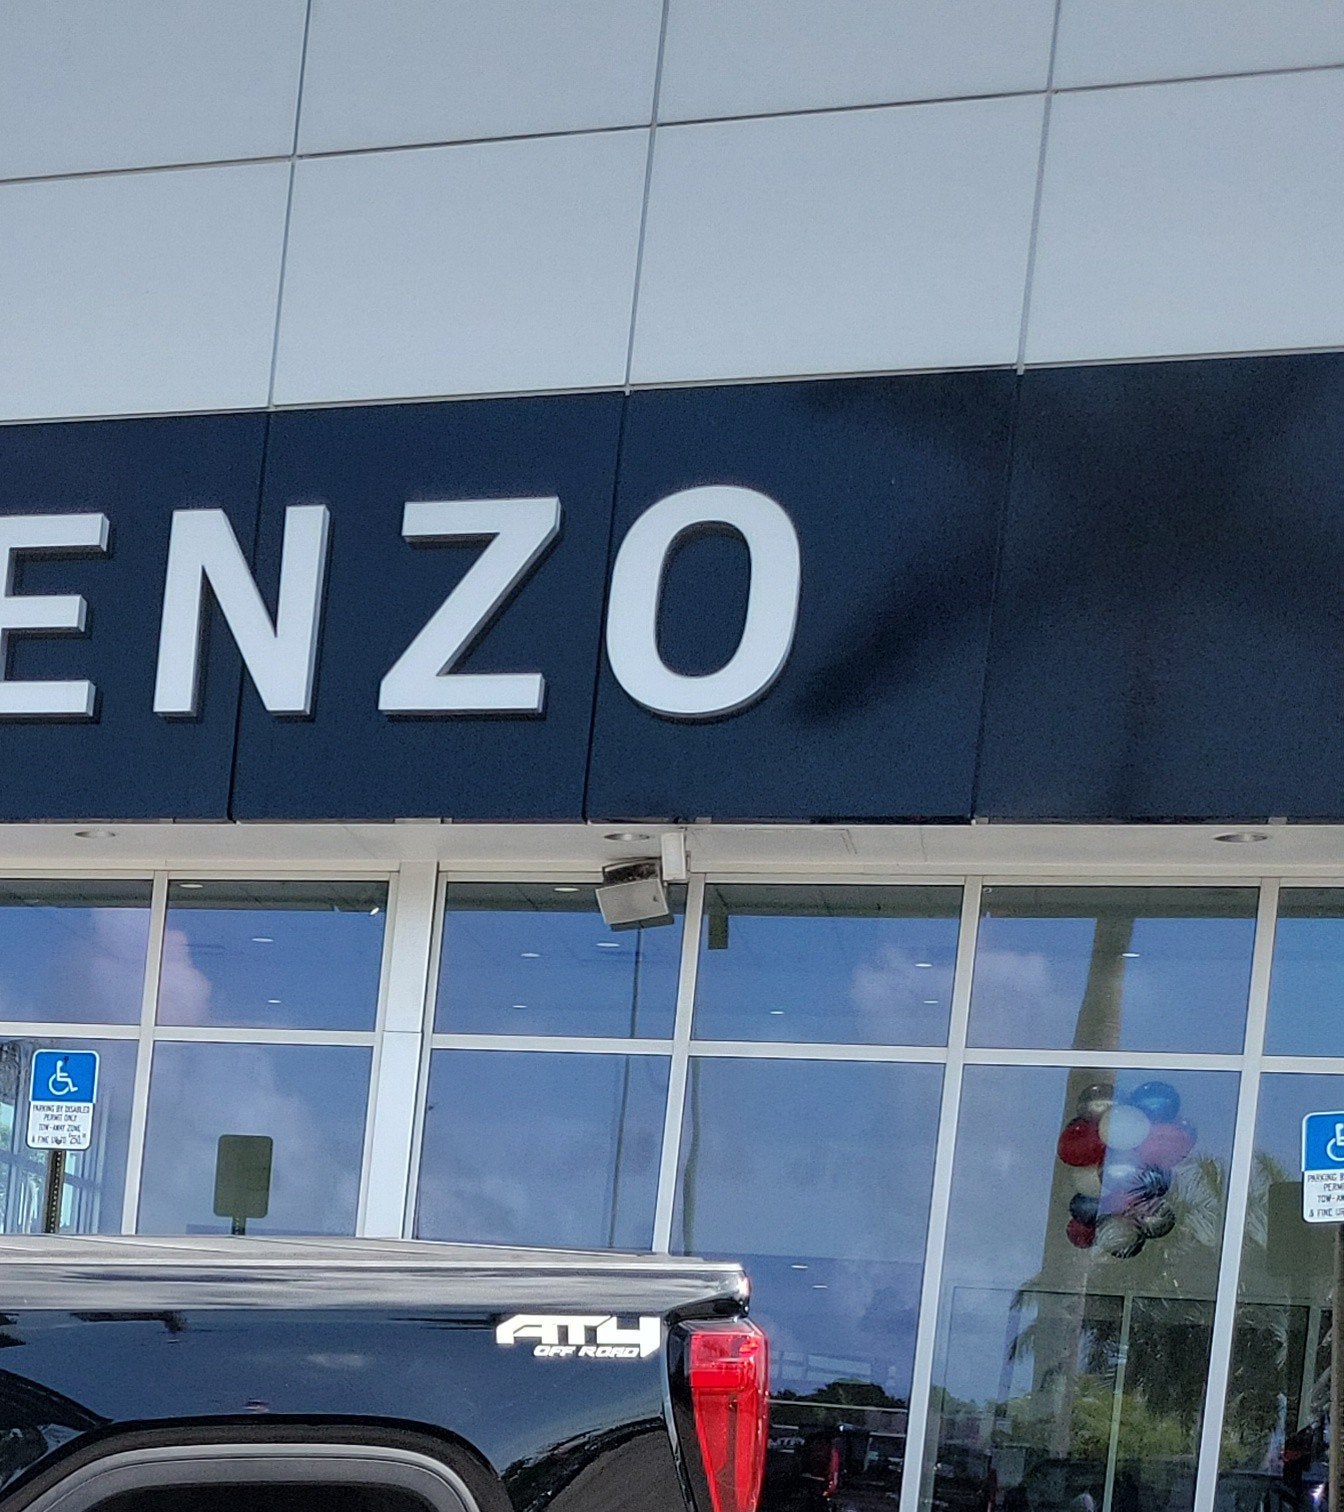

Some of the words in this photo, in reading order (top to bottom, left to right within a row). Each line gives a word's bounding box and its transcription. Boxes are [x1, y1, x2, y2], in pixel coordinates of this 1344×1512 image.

[496, 1314, 661, 1357] AT4
[533, 1345, 577, 1357] OFF
[578, 1345, 640, 1357] ROAD
